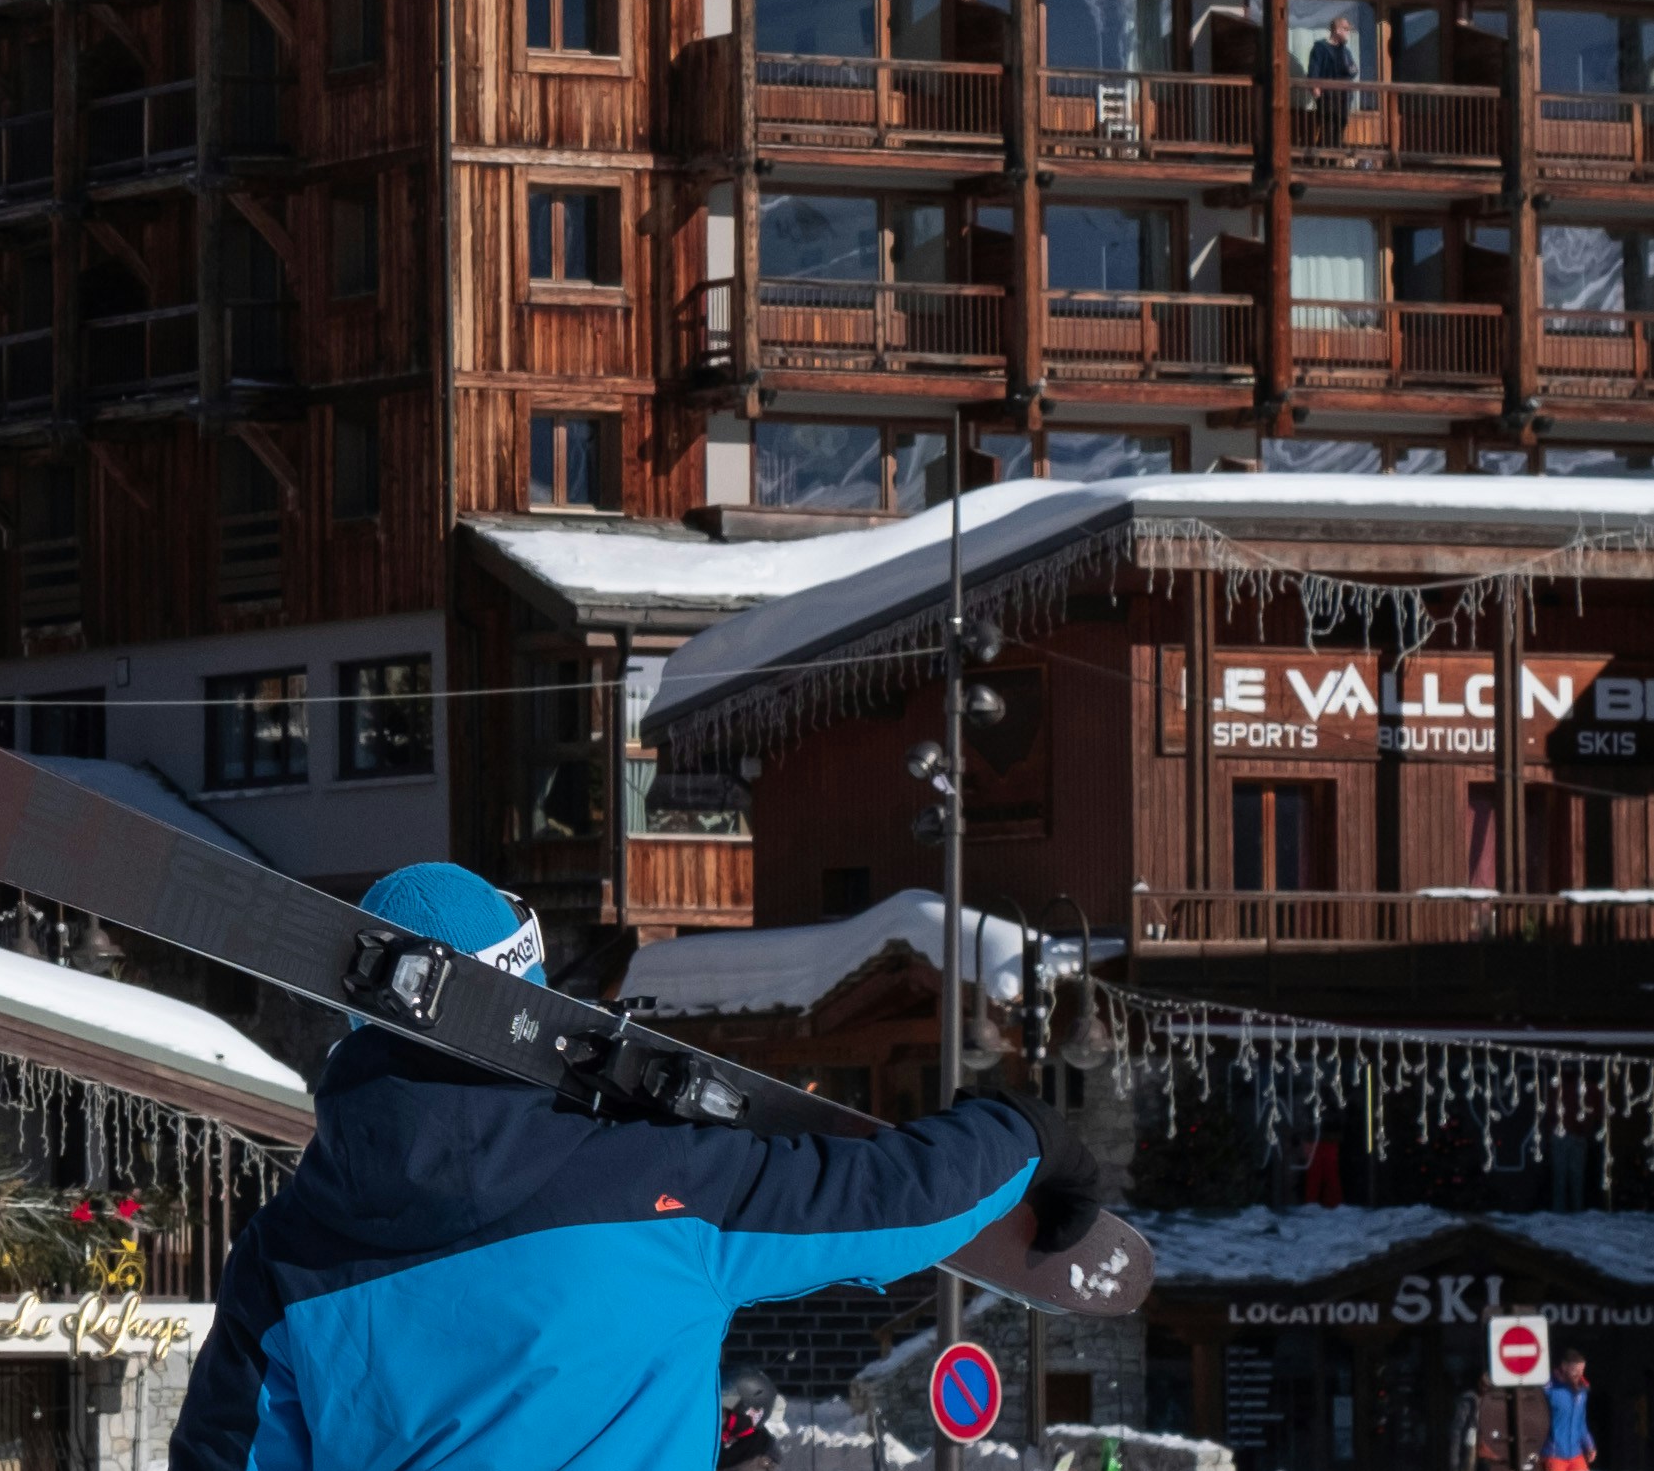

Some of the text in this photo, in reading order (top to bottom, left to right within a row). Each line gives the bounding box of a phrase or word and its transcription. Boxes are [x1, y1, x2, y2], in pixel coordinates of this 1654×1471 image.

[1286, 663, 1575, 721] VALLON
[1213, 722, 1318, 750] SPORTS
[1577, 730, 1637, 756] SKIS
[60, 1290, 191, 1361] Refuge
[1228, 1301, 1380, 1326] LOCATION
[1391, 1275, 1504, 1324] SKI
